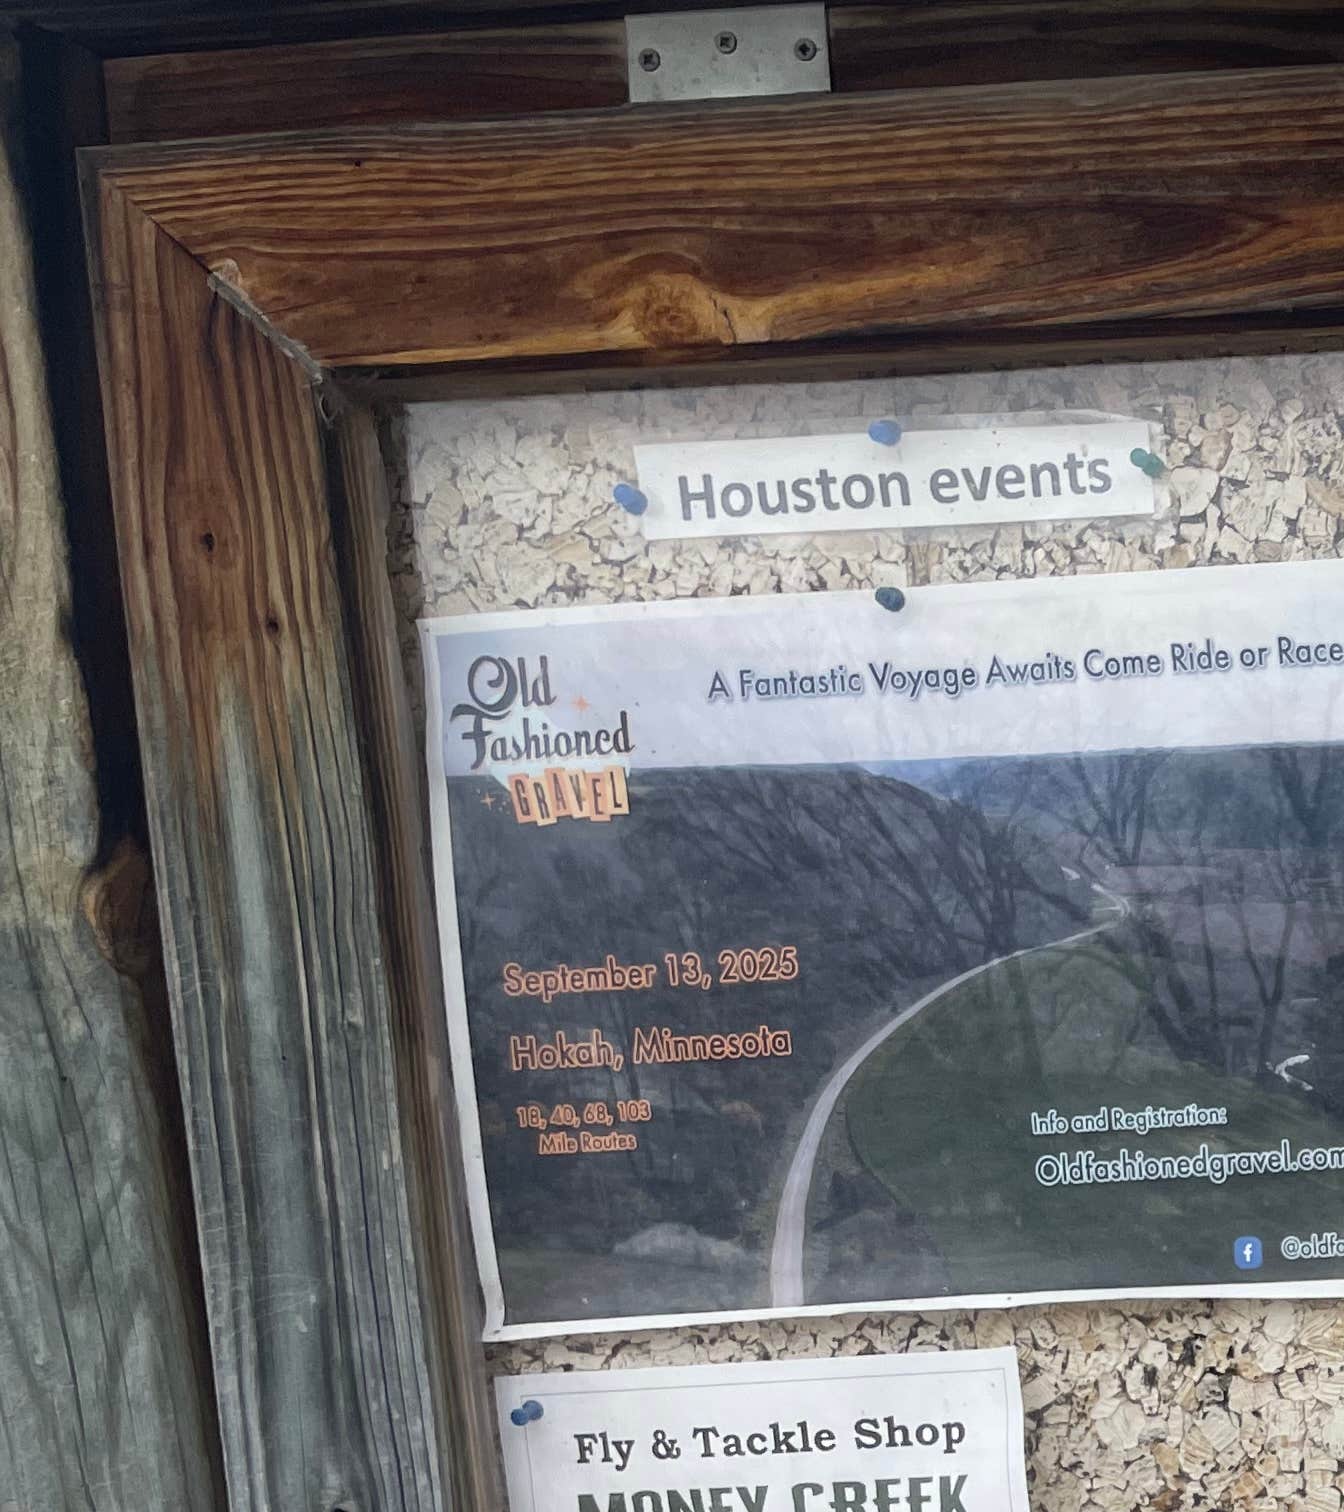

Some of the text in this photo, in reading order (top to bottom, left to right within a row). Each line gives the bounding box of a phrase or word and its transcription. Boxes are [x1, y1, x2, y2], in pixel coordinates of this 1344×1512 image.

[677, 451, 1114, 522] Houston events
[467, 655, 557, 713] Old
[708, 671, 730, 699] A
[739, 664, 862, 698] Fantastic
[868, 662, 976, 698] Voyage
[985, 651, 1075, 684] Awaits
[1083, 648, 1161, 678] Come
[1170, 638, 1231, 673] Ride
[1239, 644, 1269, 668] or
[1277, 635, 1344, 665] Race
[450, 703, 635, 770] Fashioned
[513, 769, 624, 820] GRAVEL
[503, 946, 799, 1001] September 13, 2025
[510, 1025, 792, 1072] Hokah, Minnesota
[516, 1099, 652, 1129] 18, 40, 68, 103
[1031, 1104, 1228, 1136] Info and Registration:
[538, 1130, 637, 1156] Mile Routes
[574, 1415, 966, 1472] Fly & Tackle Shop
